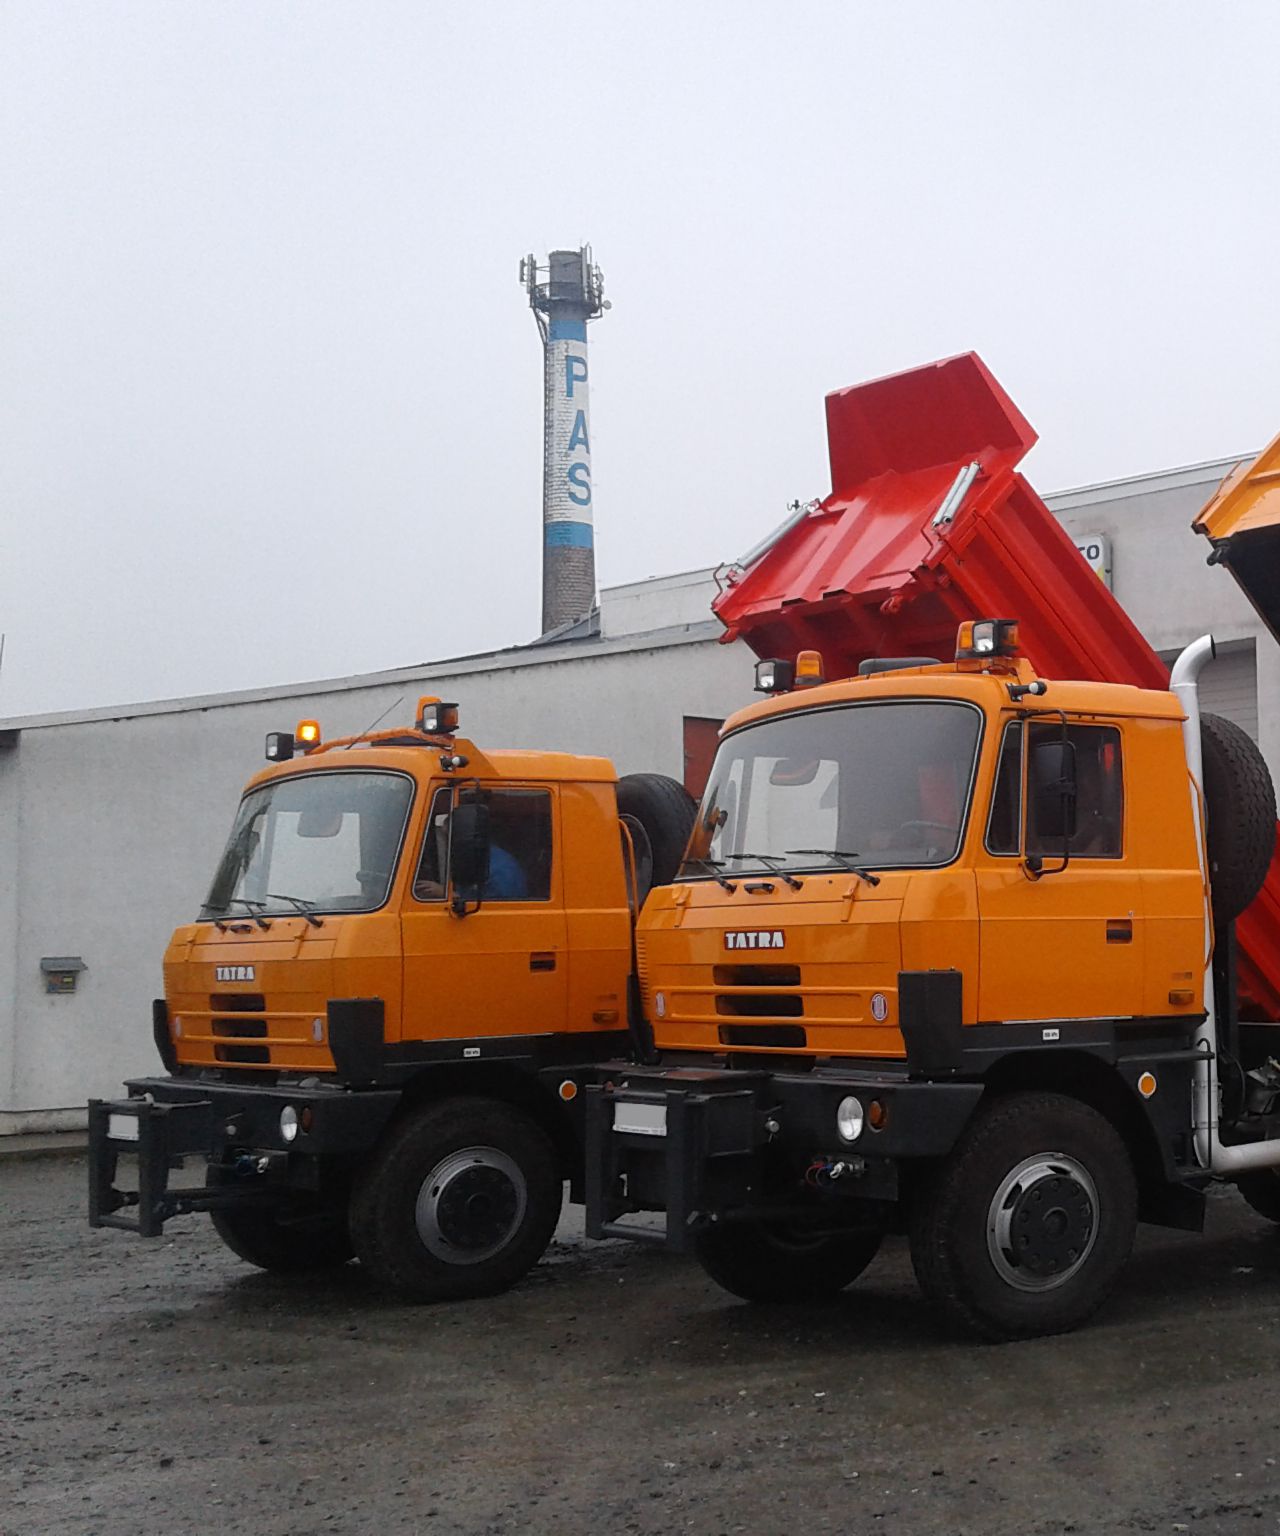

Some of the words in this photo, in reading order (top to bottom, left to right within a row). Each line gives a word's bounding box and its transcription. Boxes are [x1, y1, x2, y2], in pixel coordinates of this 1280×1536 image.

[565, 354, 592, 506] PAS
[725, 931, 784, 949] TATRA
[216, 966, 255, 981] TATRA
